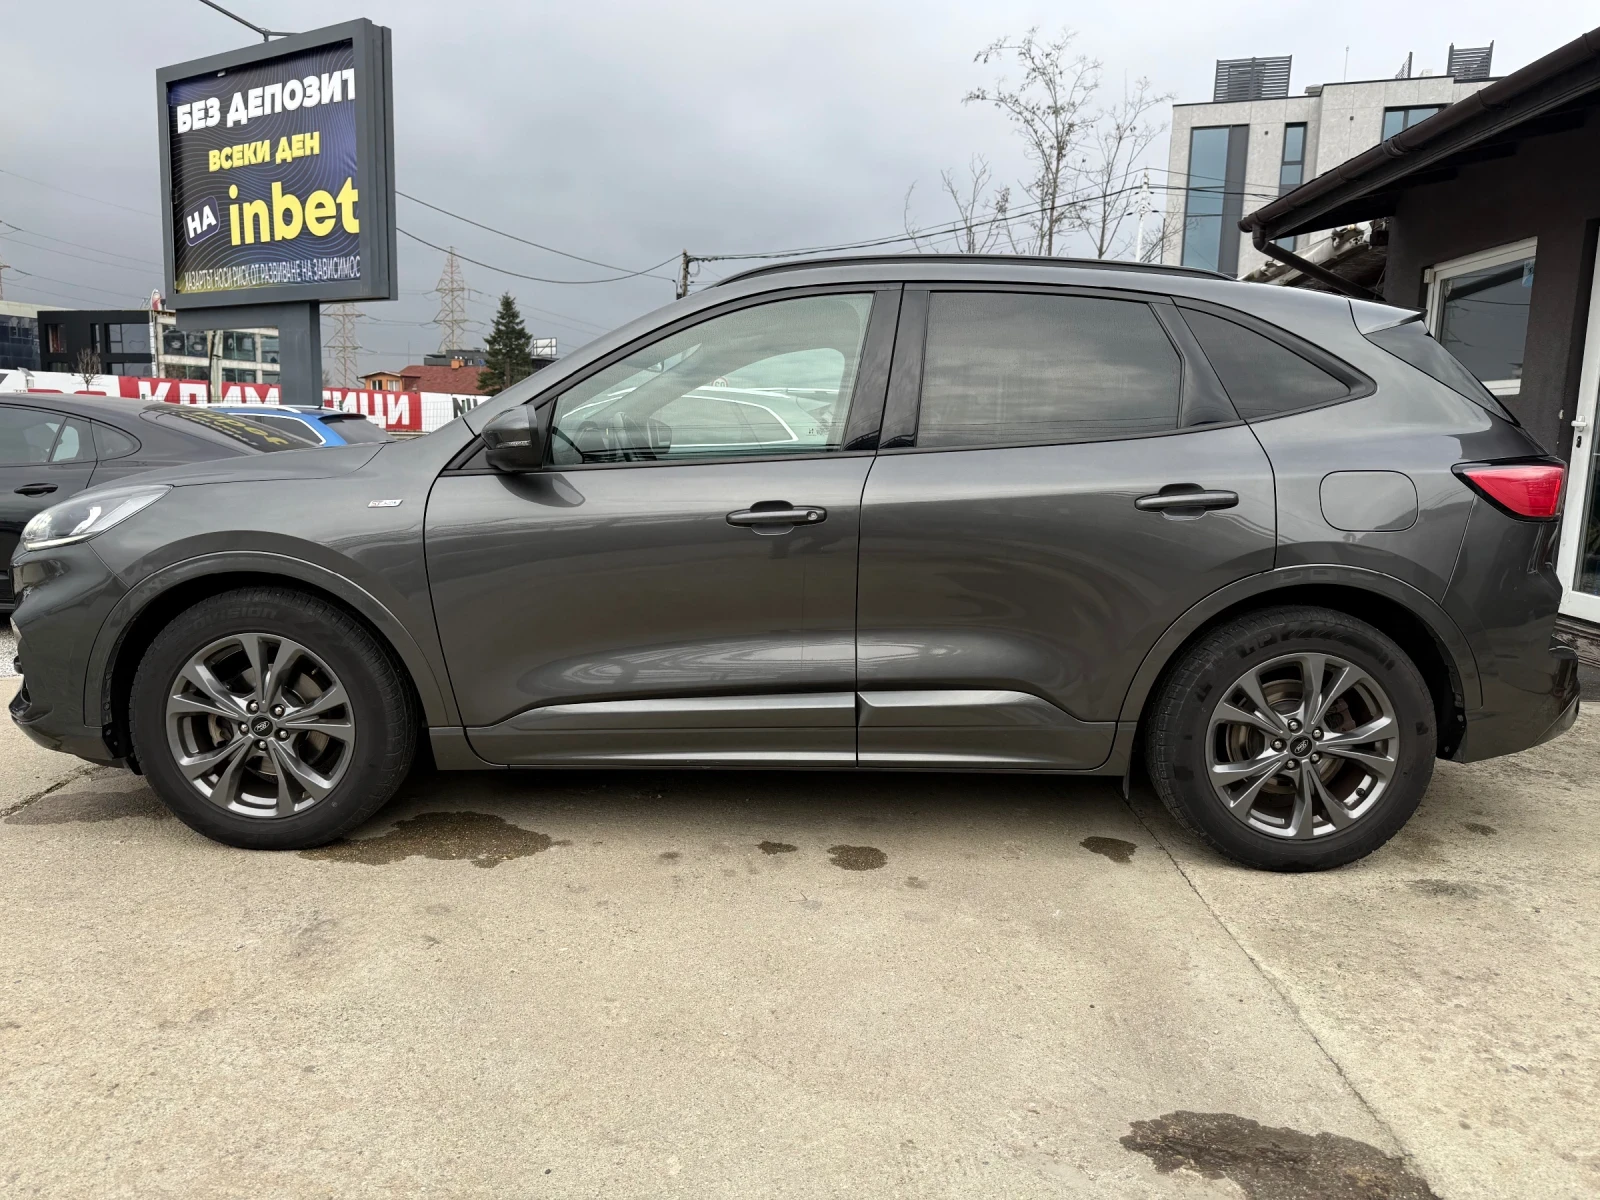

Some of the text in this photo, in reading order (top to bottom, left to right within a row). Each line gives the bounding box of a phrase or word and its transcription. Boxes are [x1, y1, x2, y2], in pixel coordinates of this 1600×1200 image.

[176, 68, 356, 134] БЕЗ ДЕПОЗИТ
[208, 131, 320, 172] ВСЕКИ ДЕН
[186, 176, 360, 246] НА inbet
[251, 263, 260, 285] ОТ
